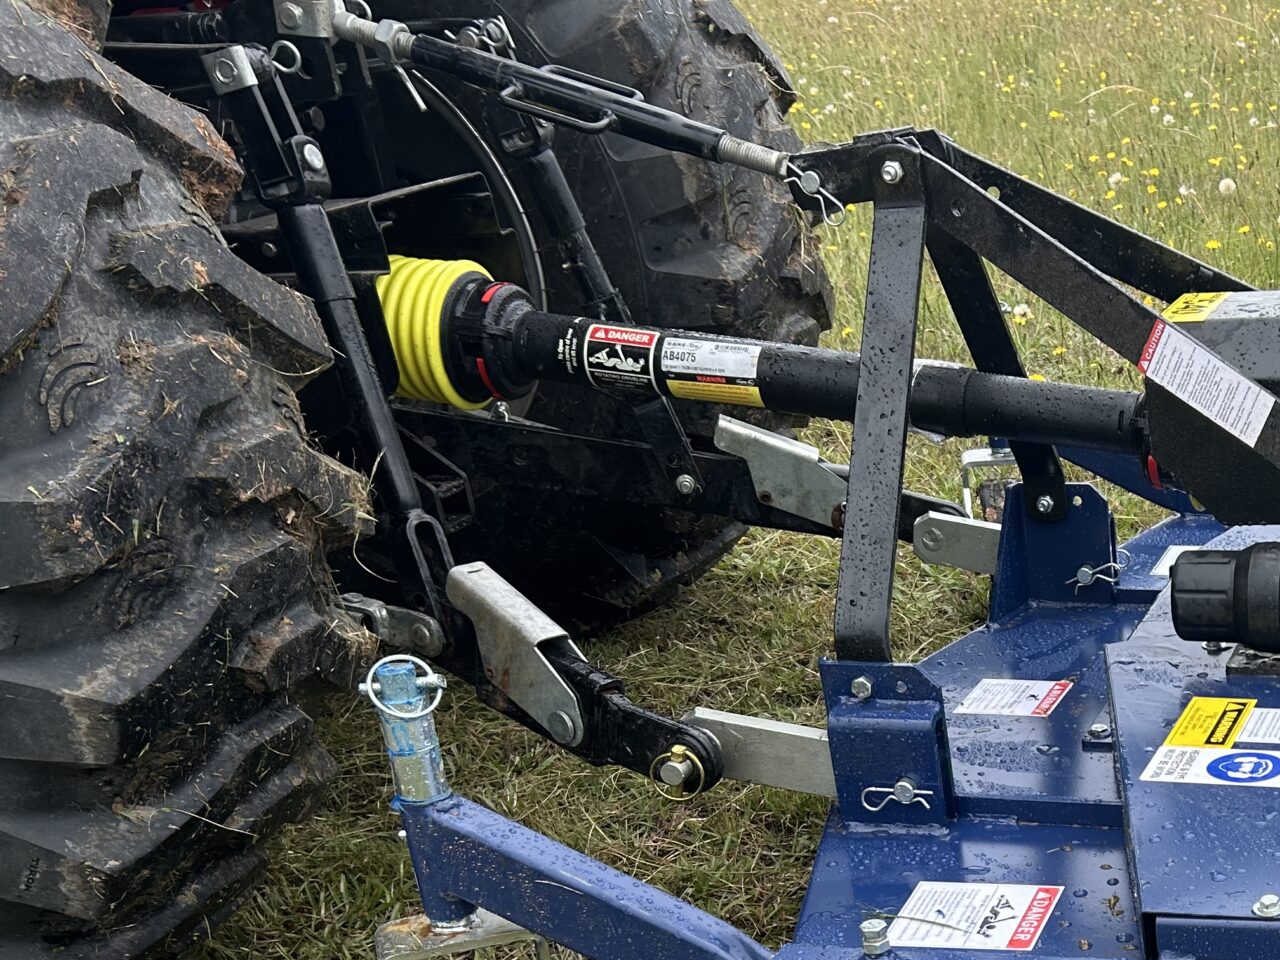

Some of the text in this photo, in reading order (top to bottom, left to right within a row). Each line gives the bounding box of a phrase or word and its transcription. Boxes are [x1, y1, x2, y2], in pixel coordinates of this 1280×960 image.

[607, 330, 650, 343] DANGER
[1145, 322, 1164, 360] CAUTION
[662, 350, 697, 363] AB4075
[1208, 710, 1239, 743] WARNING
[1012, 899, 1049, 940] DANGER
